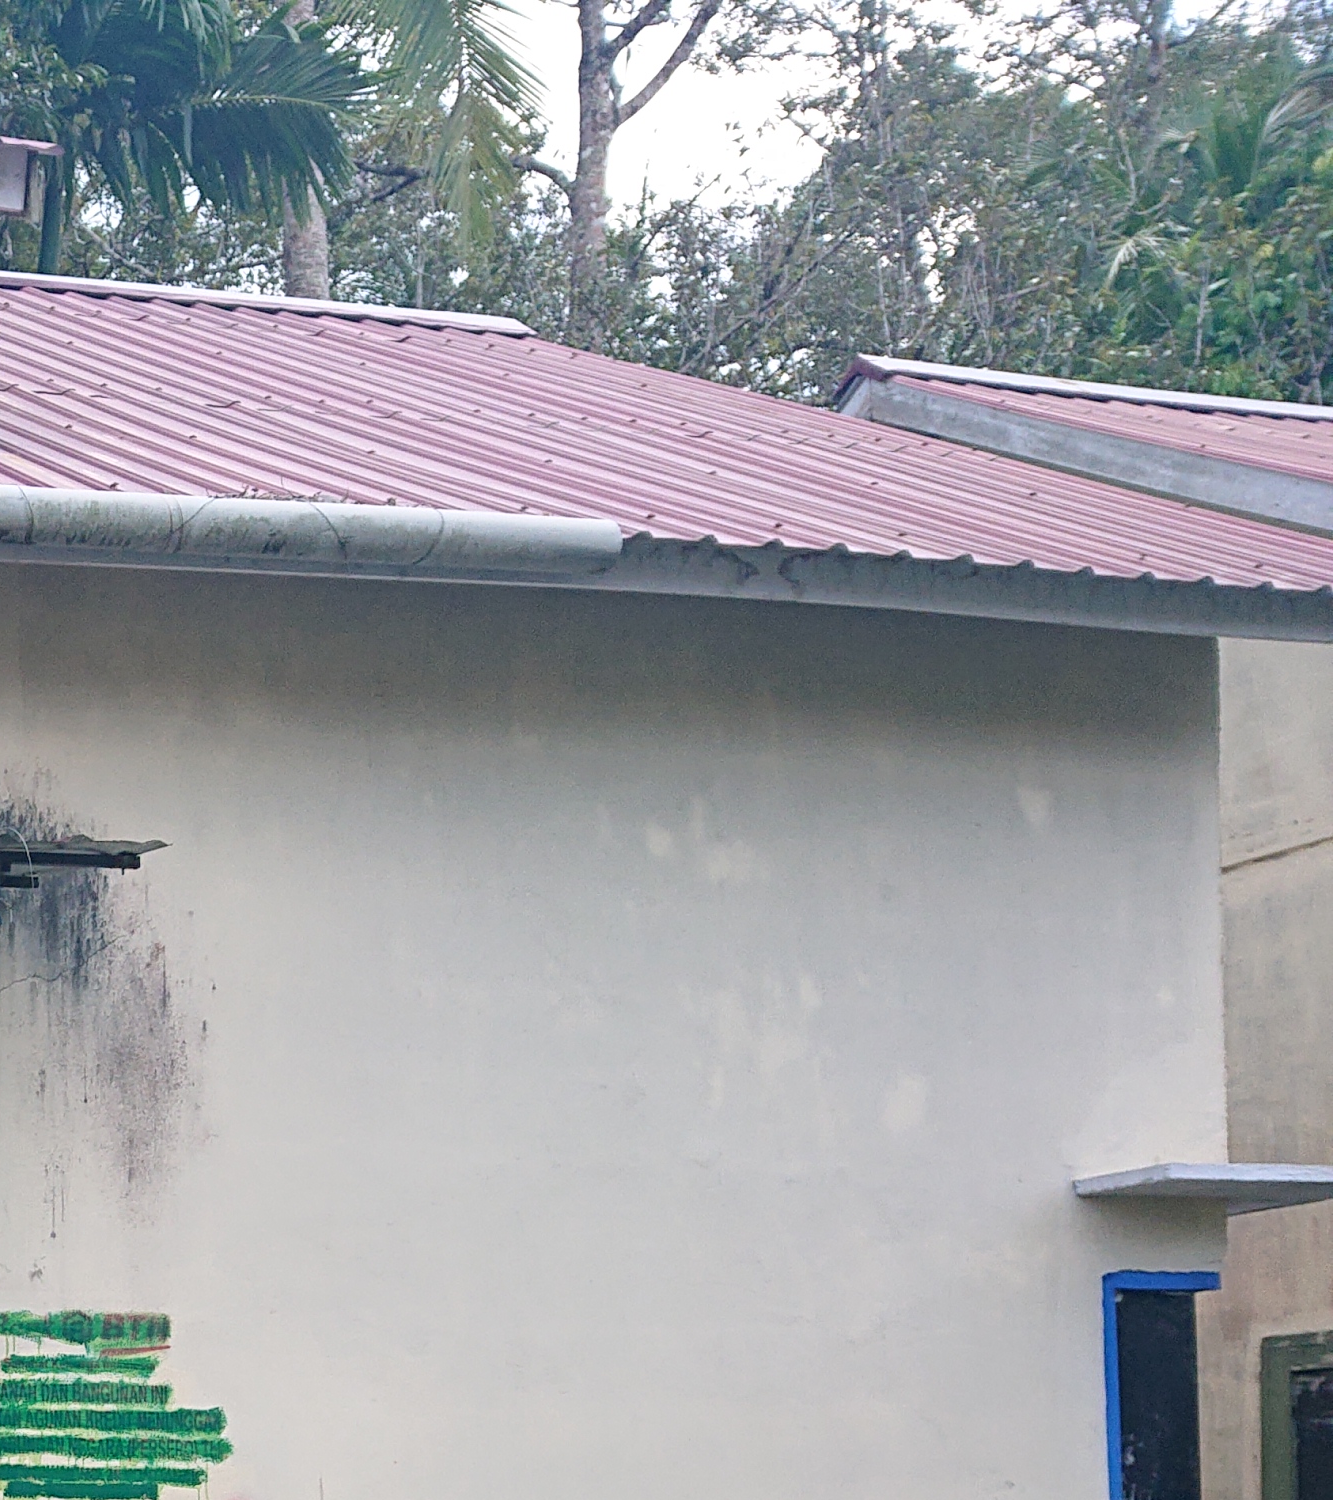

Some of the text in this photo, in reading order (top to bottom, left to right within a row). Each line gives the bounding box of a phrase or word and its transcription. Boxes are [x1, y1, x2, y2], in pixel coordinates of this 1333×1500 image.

[41, 1383, 69, 1402] DAN
[73, 1383, 148, 1403] BANGUNAN
[151, 1385, 169, 1404] INI
